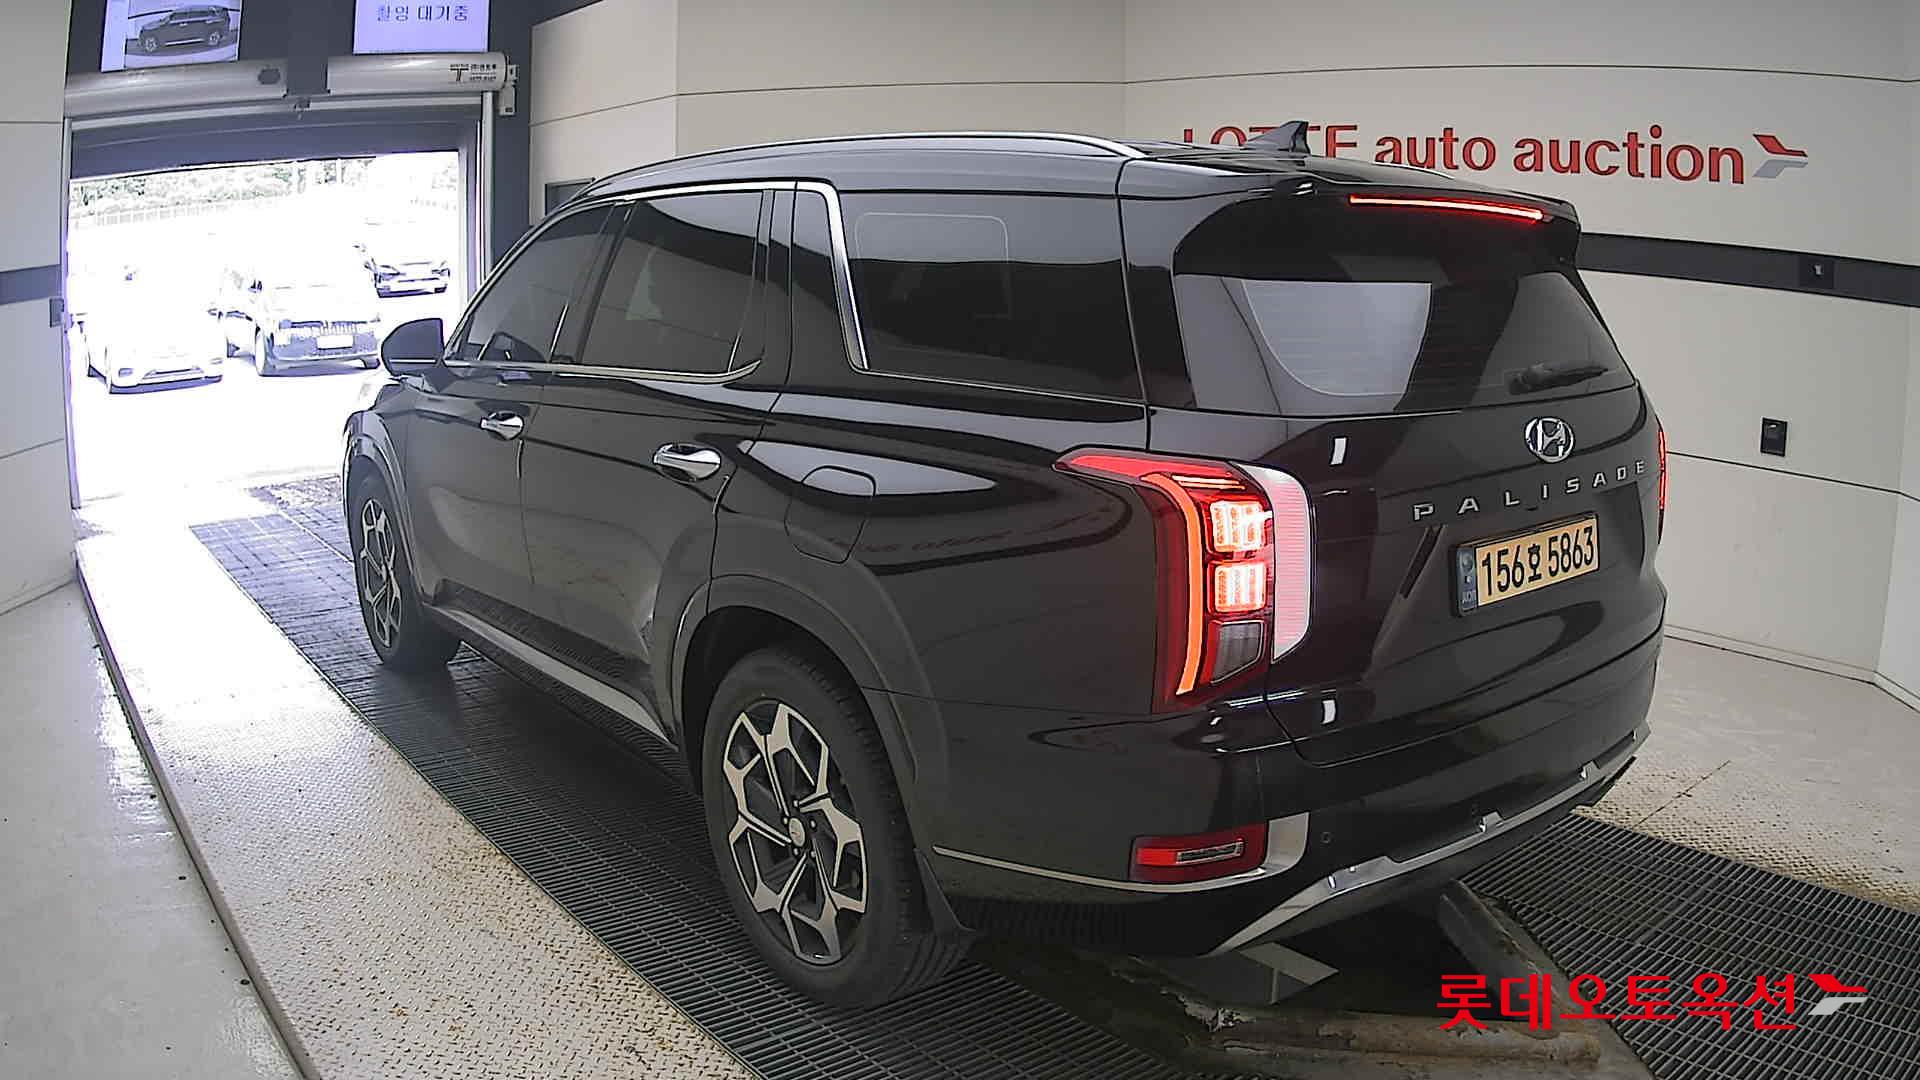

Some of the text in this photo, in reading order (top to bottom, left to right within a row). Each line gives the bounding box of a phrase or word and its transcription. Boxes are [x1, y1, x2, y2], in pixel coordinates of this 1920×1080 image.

[417, 5, 468, 21] 대기중
[1375, 127, 1498, 171] auto
[1513, 124, 1744, 184] auction
[1413, 460, 1646, 521] PALISADE
[1481, 524, 1594, 597] 156호 5863
